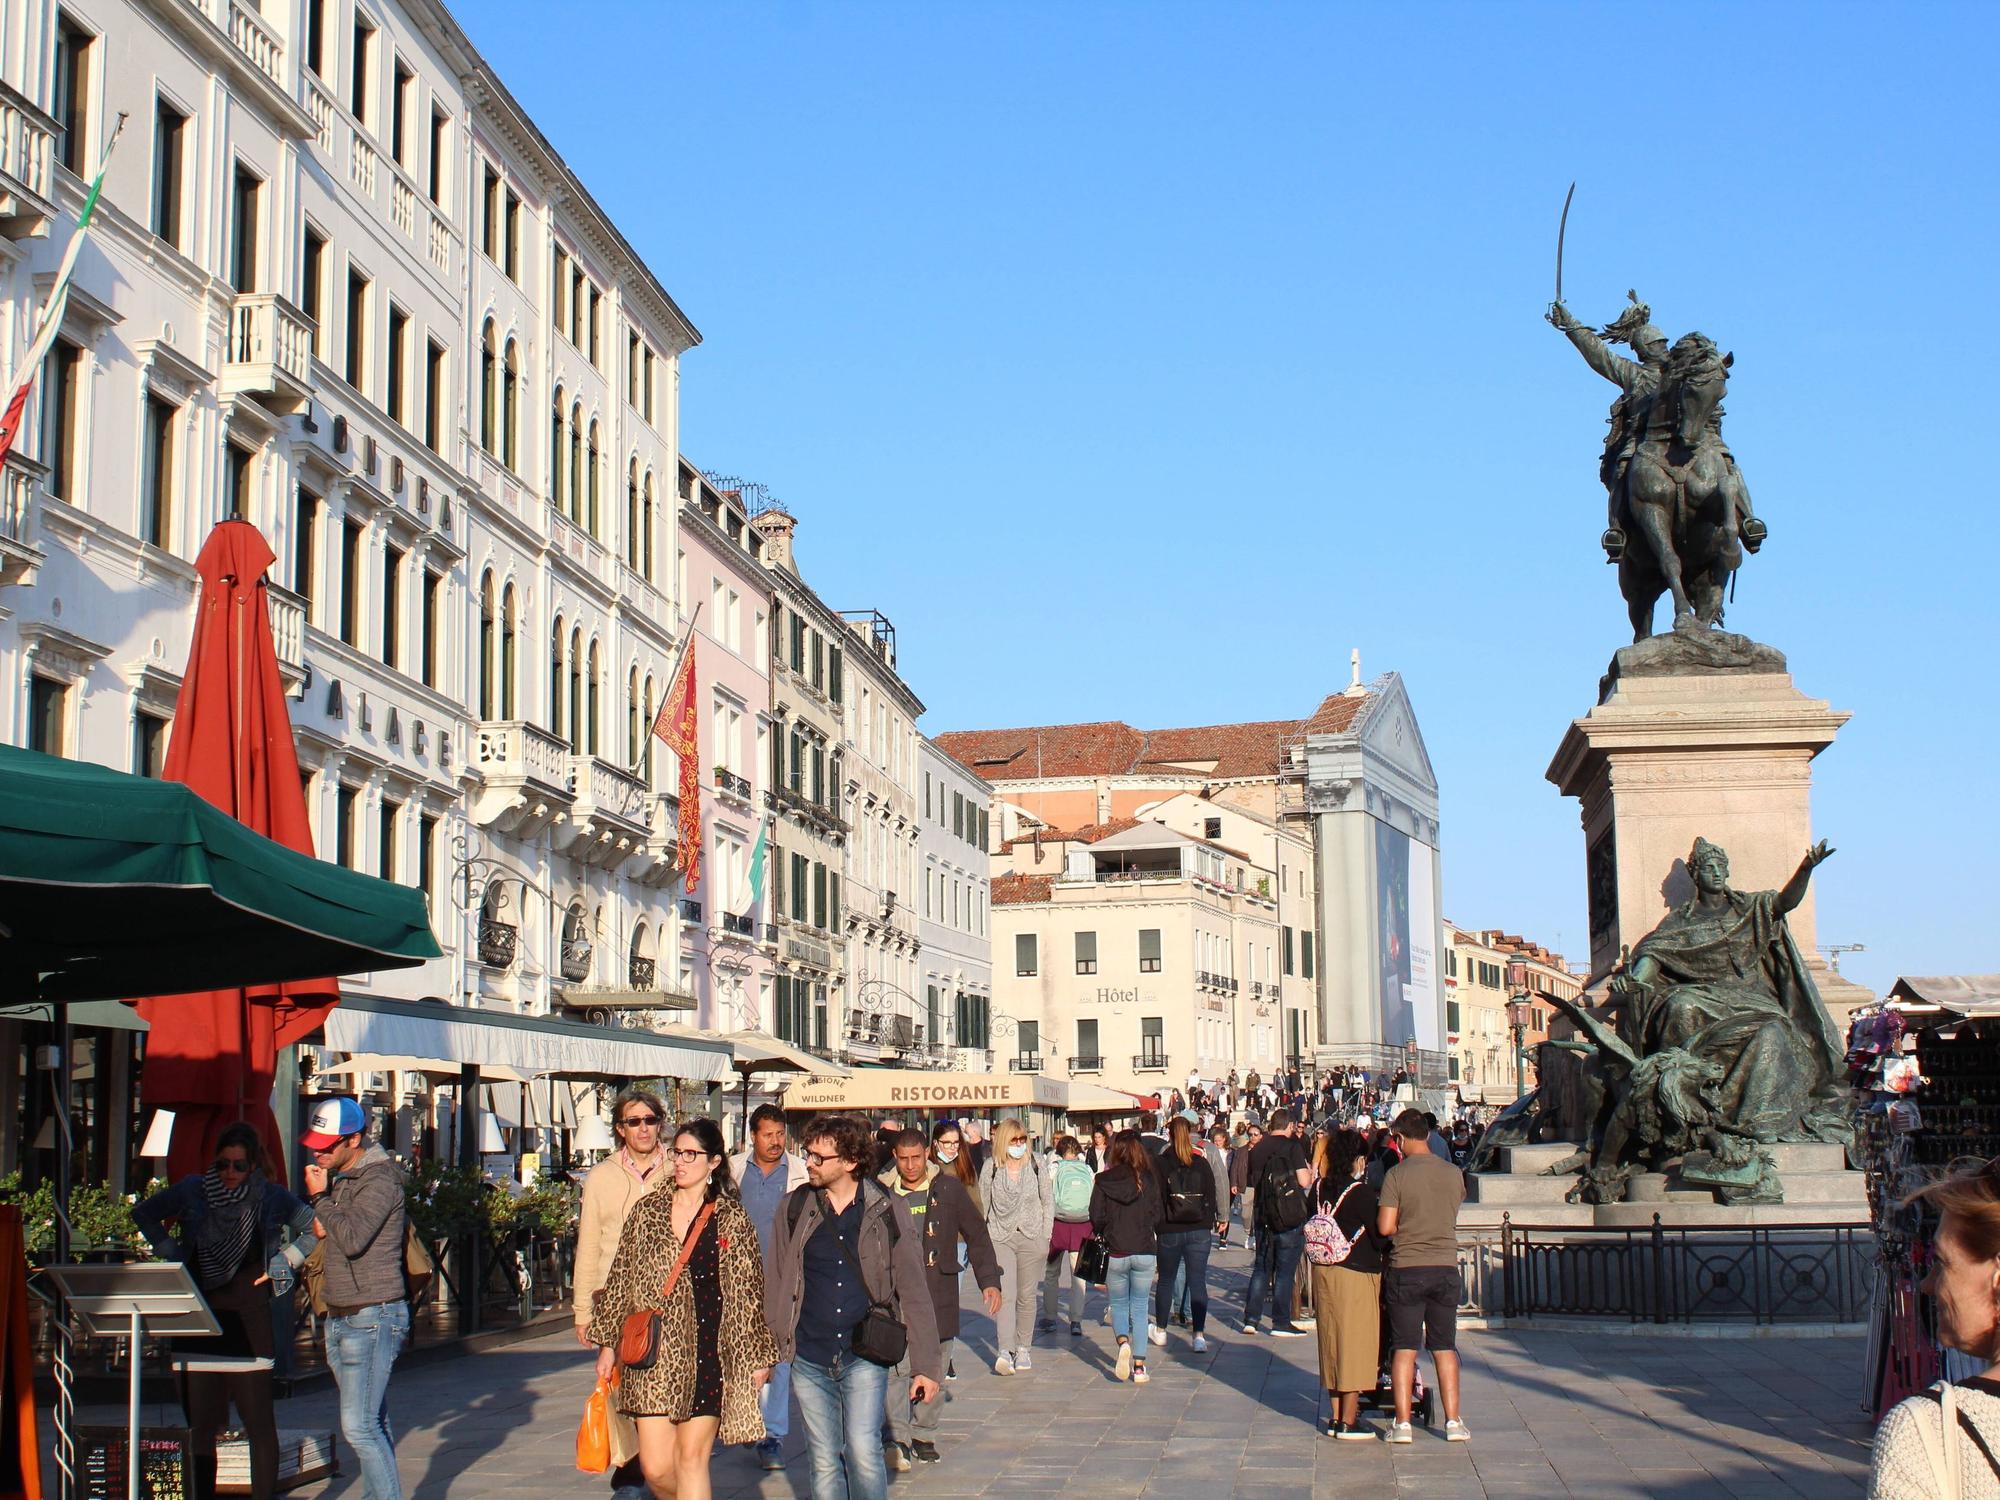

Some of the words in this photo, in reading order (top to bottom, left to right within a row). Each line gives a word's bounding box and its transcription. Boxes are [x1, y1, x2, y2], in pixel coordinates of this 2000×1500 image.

[303, 399, 451, 531] LONDRA
[297, 664, 450, 767] PALACE
[1096, 986, 1139, 1003] Hôtel
[801, 1076, 846, 1089] PENSIONE
[801, 1094, 846, 1103] WILDNER
[891, 1085, 1010, 1101] RISTORANTE
